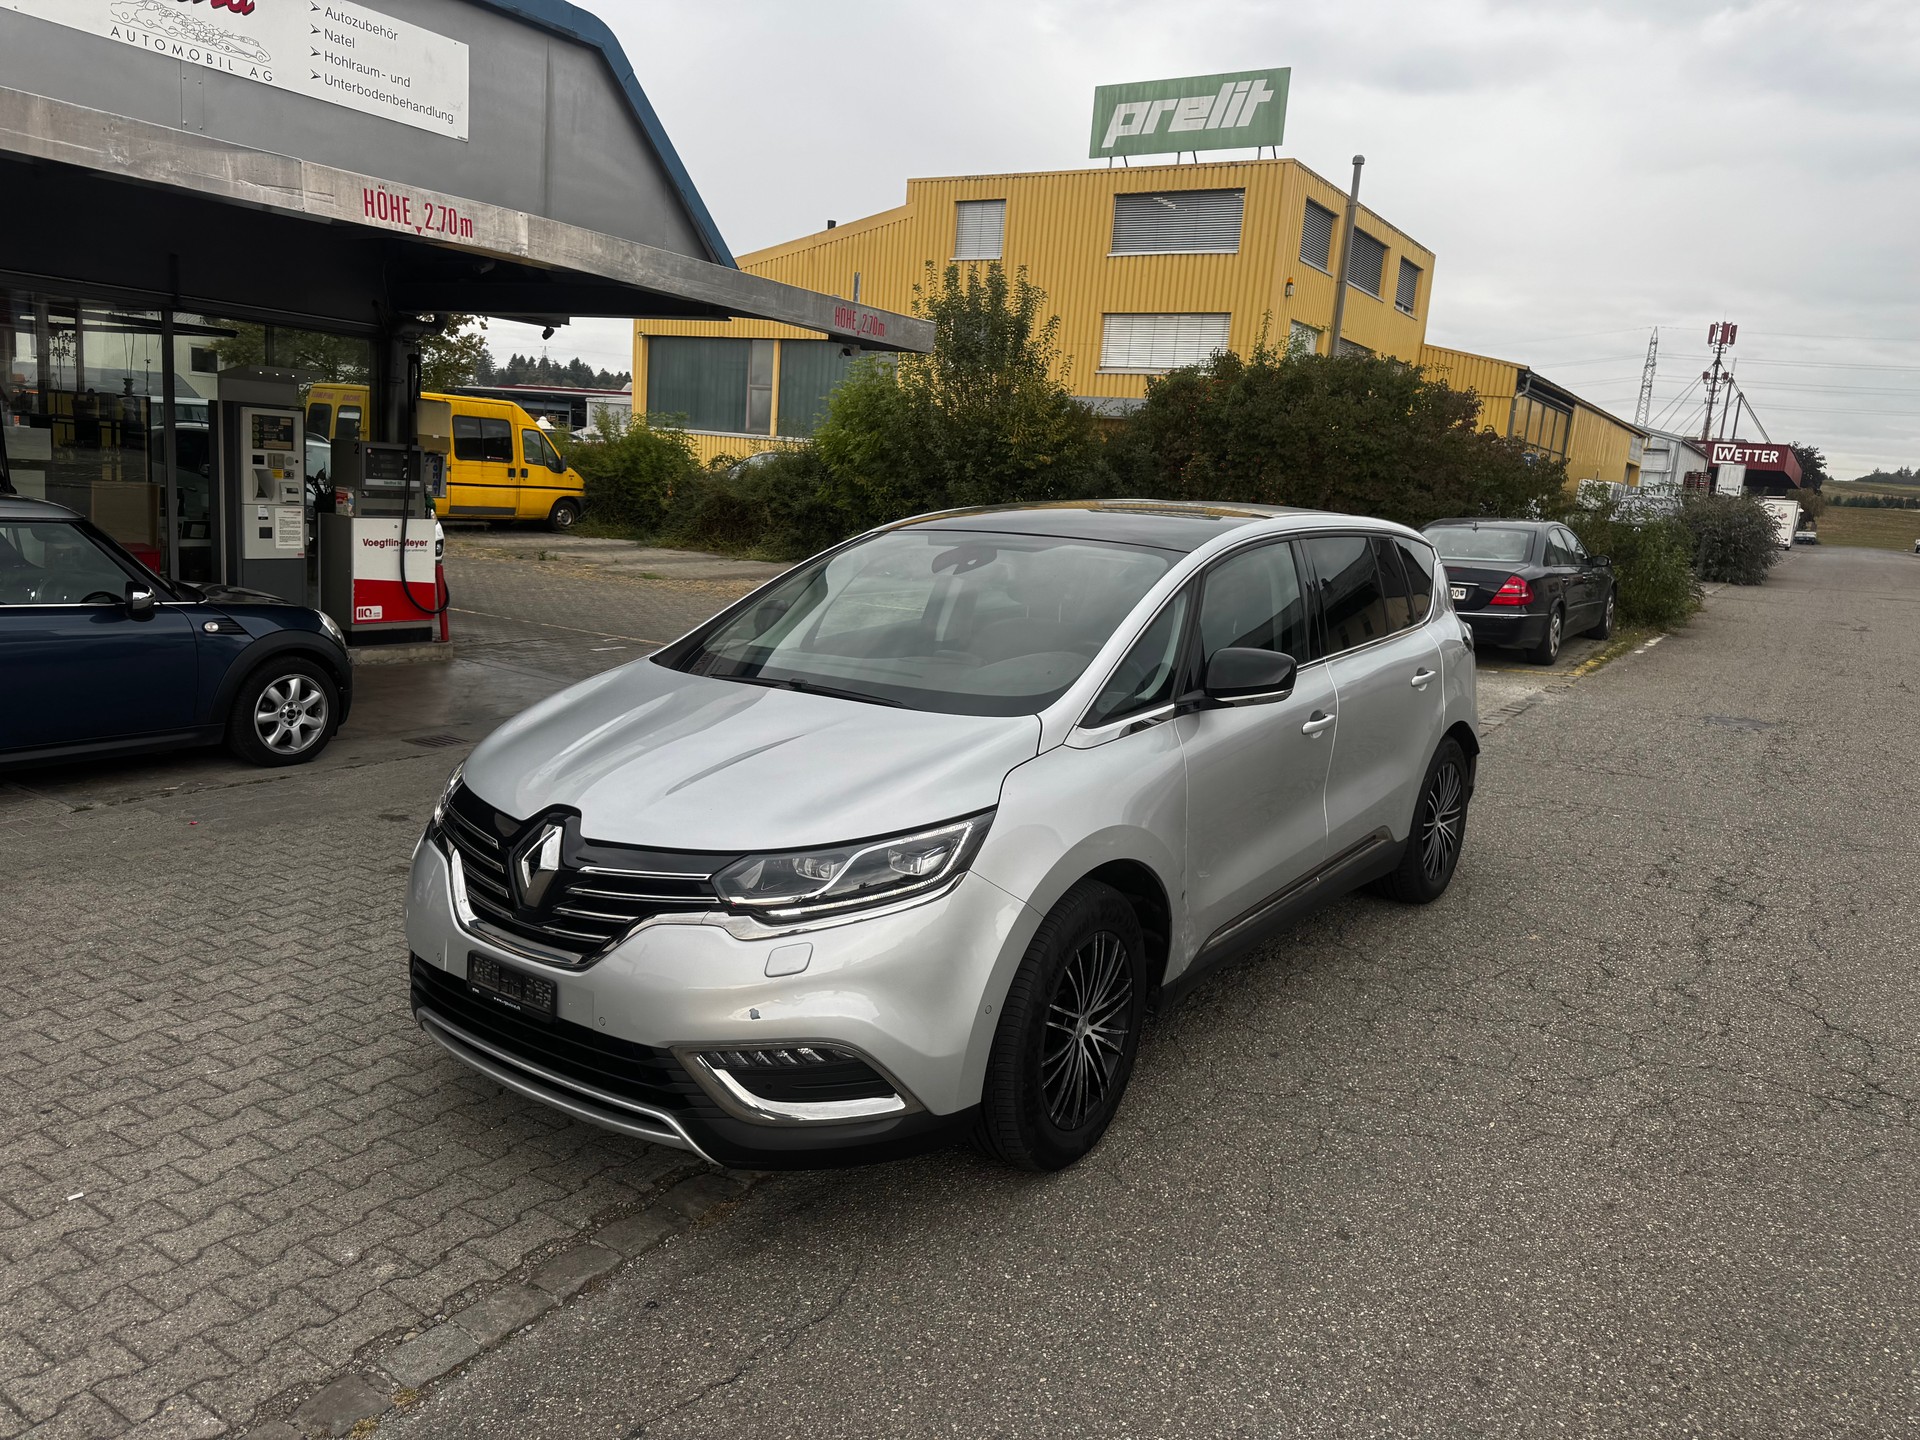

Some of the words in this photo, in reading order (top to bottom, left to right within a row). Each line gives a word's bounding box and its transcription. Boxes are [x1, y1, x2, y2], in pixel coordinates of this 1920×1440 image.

[324, 6, 398, 41] Autozubehör
[324, 27, 355, 49] Natel
[110, 25, 234, 71] AUTOMOBIL
[249, 67, 273, 82] AG
[324, 50, 386, 79] Hohlraum-
[390, 73, 411, 88] und
[324, 73, 454, 124] Unterbodenbehandlung
[1101, 79, 1274, 149] prelit
[363, 184, 412, 226] HÖHE
[834, 303, 857, 330] HÖHE
[1714, 444, 1779, 463] WETTER
